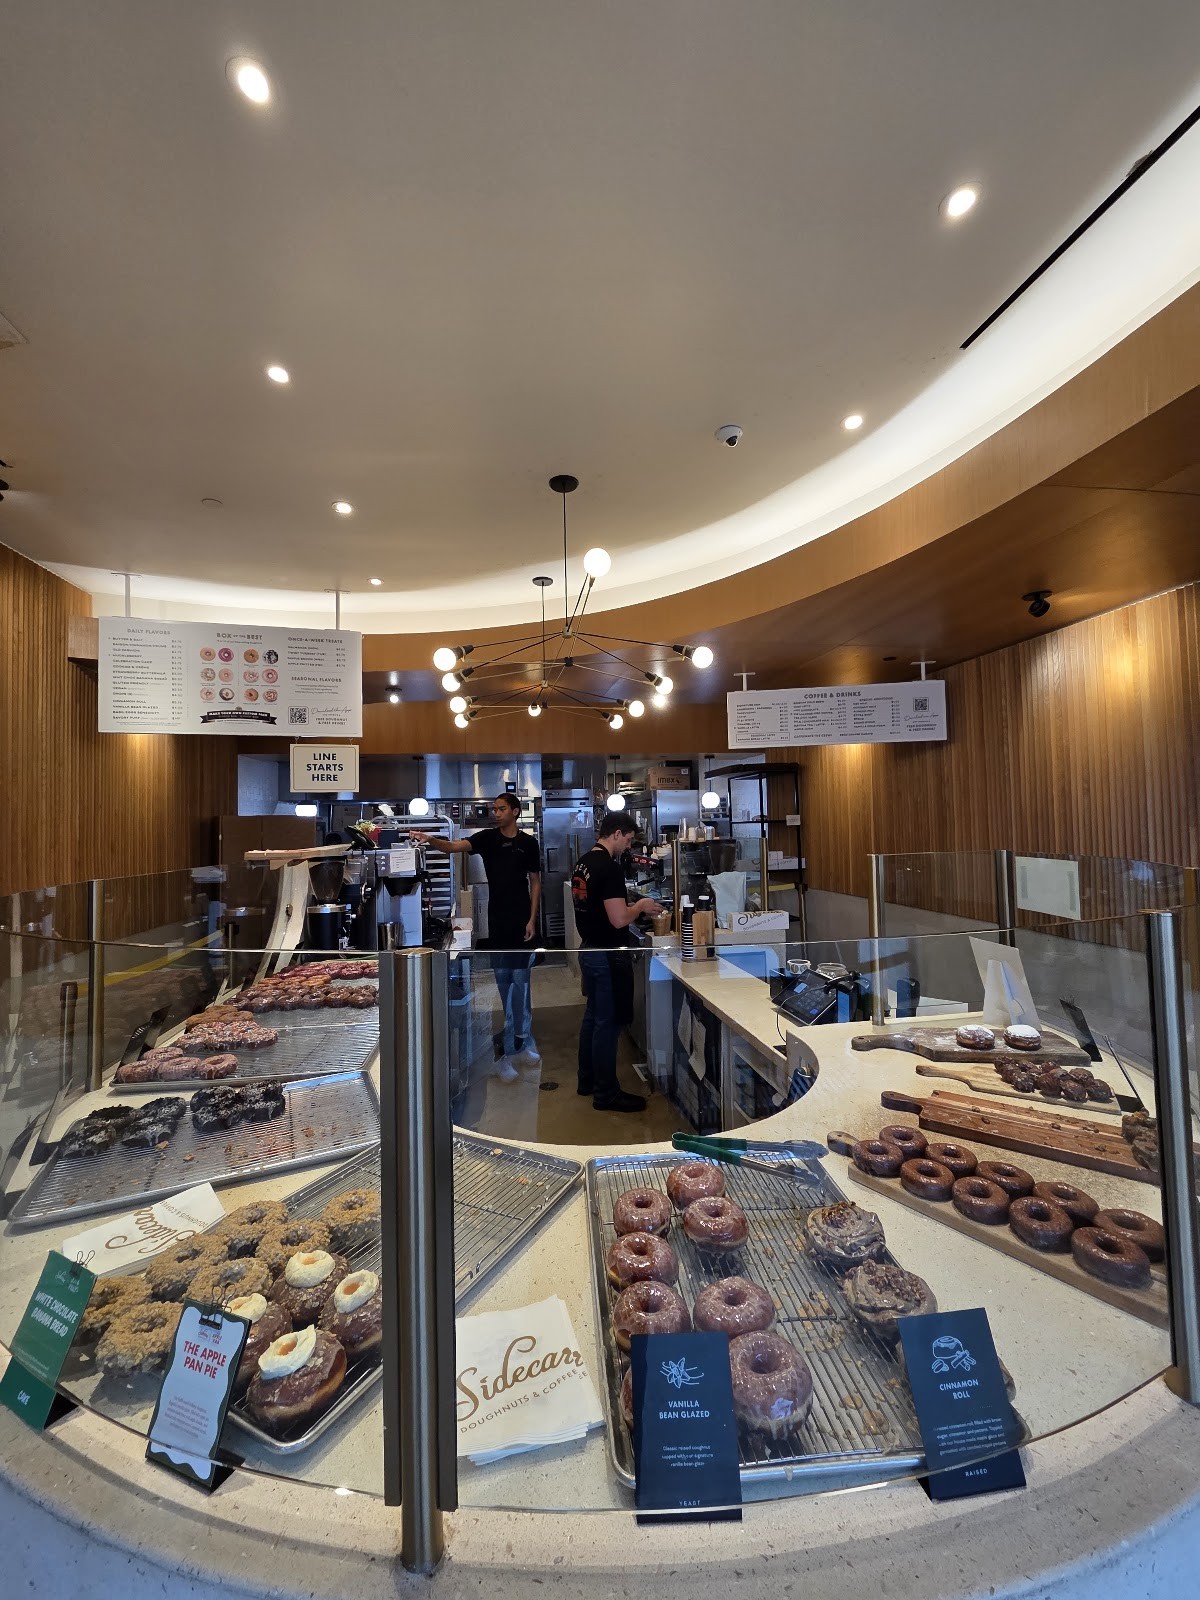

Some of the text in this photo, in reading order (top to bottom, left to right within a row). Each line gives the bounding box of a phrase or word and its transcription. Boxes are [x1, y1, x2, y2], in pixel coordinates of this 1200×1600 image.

[35, 1291, 78, 1323] WHITE CHOCOLATE
[31, 1307, 69, 1337] BANANA BREAD
[184, 1341, 226, 1367] THE APPLE
[184, 1356, 218, 1379] PAN PIE
[939, 1379, 979, 1391] CINNAMON
[952, 1391, 970, 1400] ROLL
[460, 1395, 530, 1433] DOUGHNUTS
[543, 1369, 578, 1394] COFFEE
[659, 1412, 679, 1420] BEAN
[965, 1468, 988, 1477] RAISED
